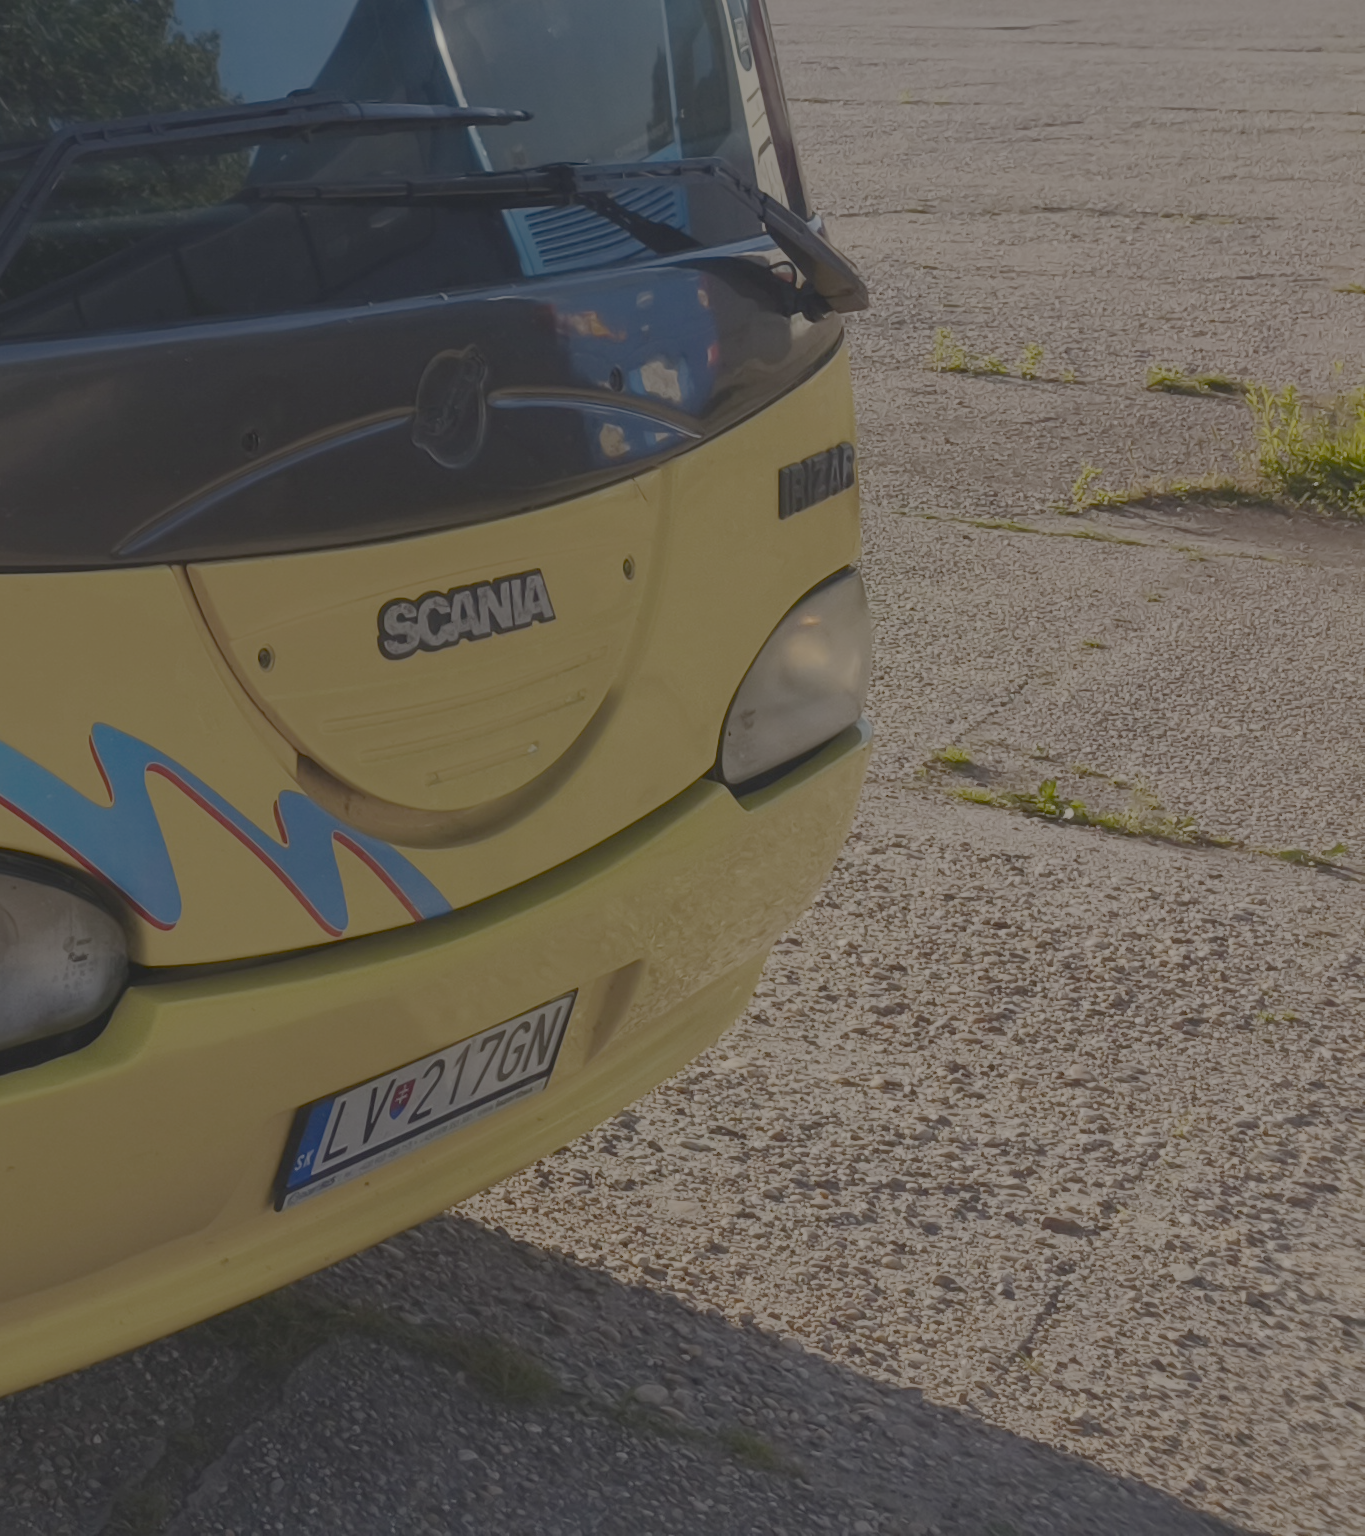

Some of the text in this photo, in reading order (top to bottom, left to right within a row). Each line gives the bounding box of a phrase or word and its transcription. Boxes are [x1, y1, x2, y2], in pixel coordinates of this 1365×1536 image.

[379, 569, 556, 659] SCANIA
[407, 1005, 562, 1125] 217GN
[294, 1149, 315, 1172] SK
